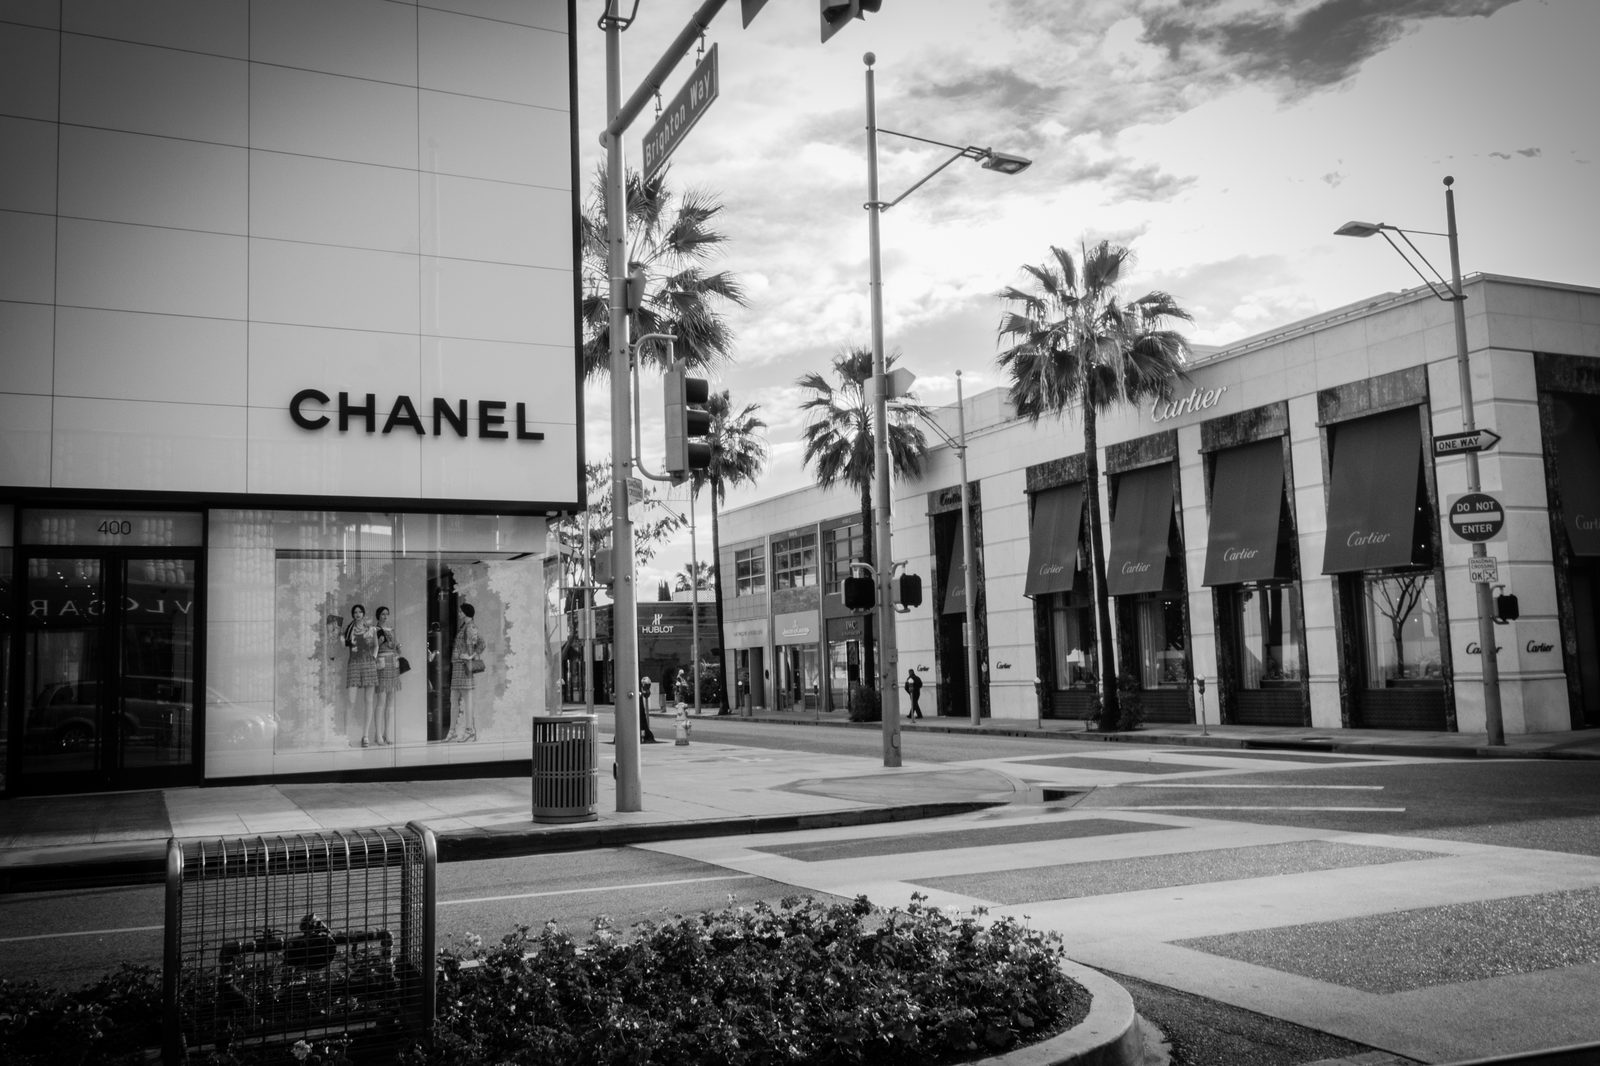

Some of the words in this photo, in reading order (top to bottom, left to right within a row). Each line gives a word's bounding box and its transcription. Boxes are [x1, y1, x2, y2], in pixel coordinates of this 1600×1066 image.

[645, 104, 686, 168] Brighton
[690, 70, 711, 110] Way
[1151, 385, 1228, 423] Cartier
[289, 388, 545, 440] CHANEL
[1438, 441, 1457, 451] ONE
[1460, 436, 1480, 448] WAY
[1456, 503, 1470, 513] DO
[1475, 501, 1495, 512] NOT
[97, 520, 132, 535] 400
[1461, 523, 1493, 534] ENTER
[1346, 530, 1391, 548] Cartier
[1223, 547, 1258, 562] Cartier
[1039, 563, 1064, 576] Cartier
[1121, 560, 1151, 575] Cartier
[1471, 571, 1483, 581] OK
[641, 625, 674, 634] HUBLOT
[1526, 640, 1555, 653] Cartier
